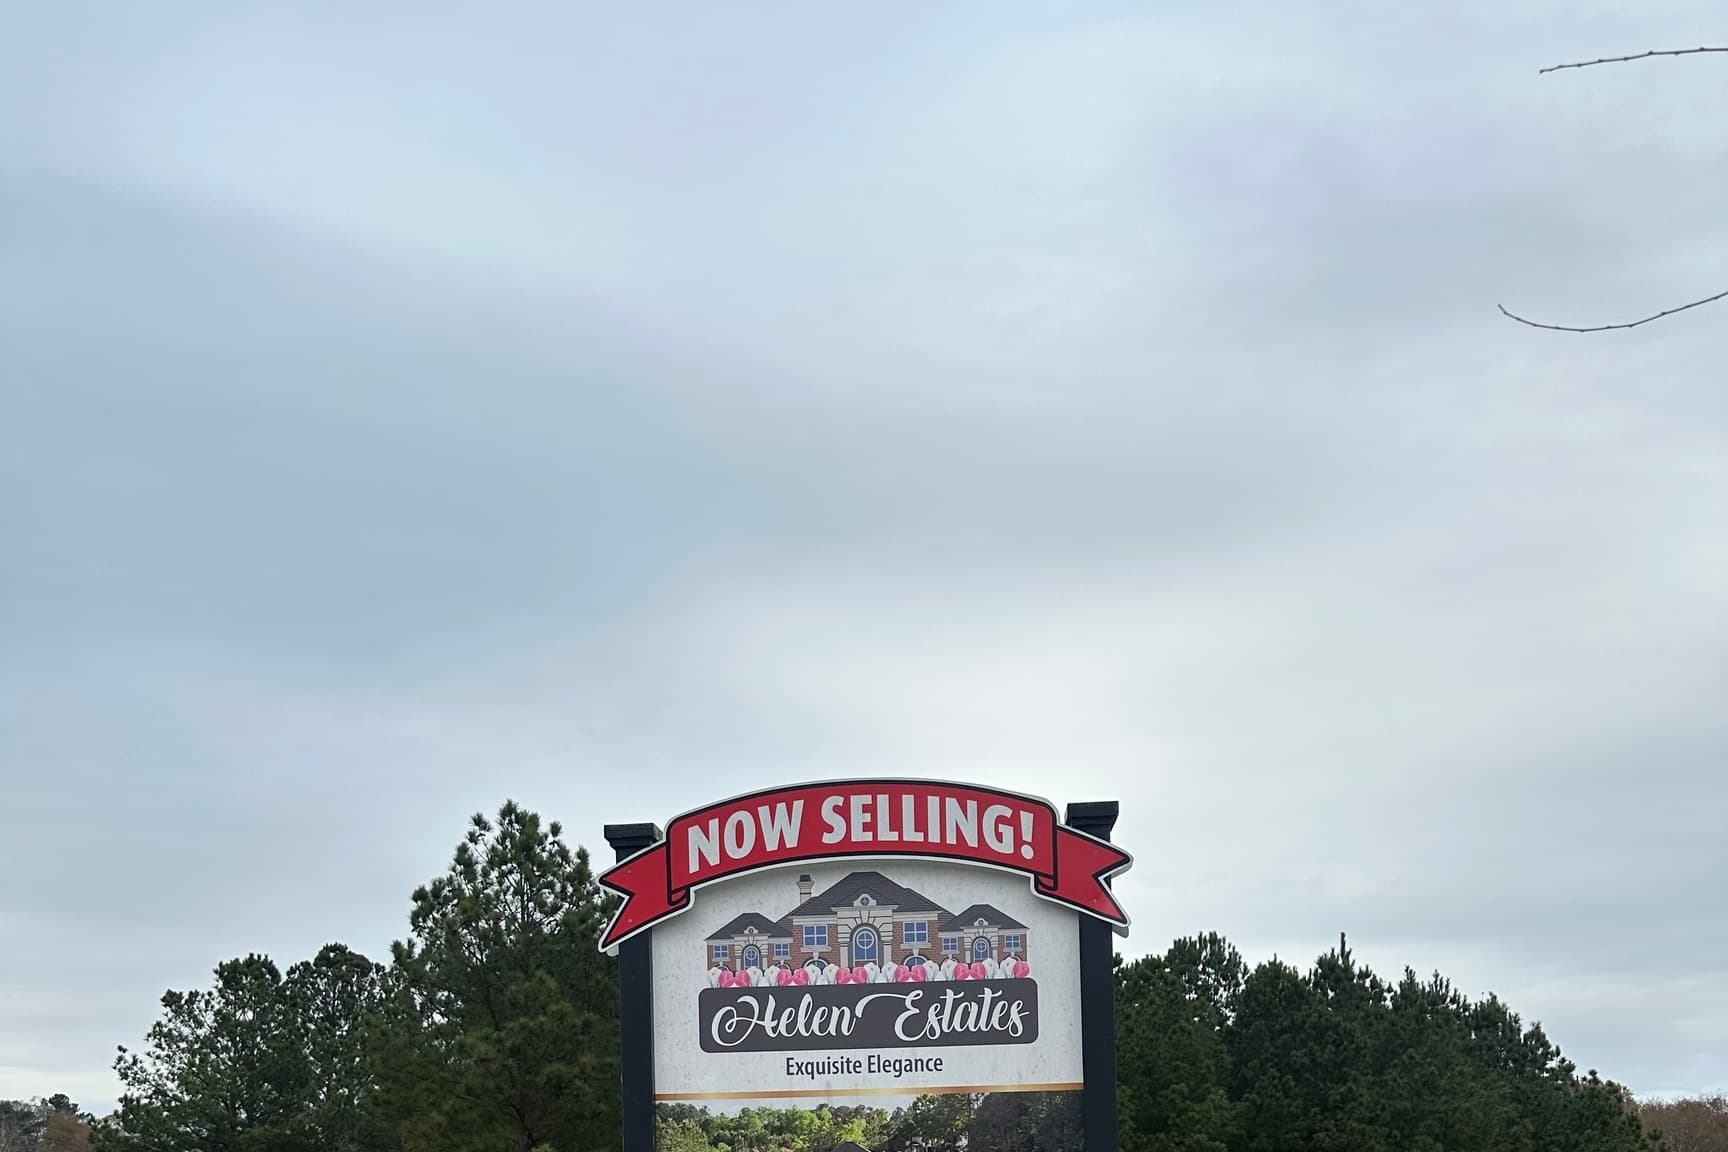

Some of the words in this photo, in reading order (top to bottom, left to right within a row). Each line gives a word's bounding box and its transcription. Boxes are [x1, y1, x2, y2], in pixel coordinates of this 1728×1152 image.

[687, 799, 804, 874] NOW
[821, 794, 1035, 860] SELLING!
[711, 993, 857, 1047] Helen
[856, 986, 1029, 1042] Estates
[785, 1055, 862, 1078] Exquisite
[868, 1053, 943, 1078] Elegance
